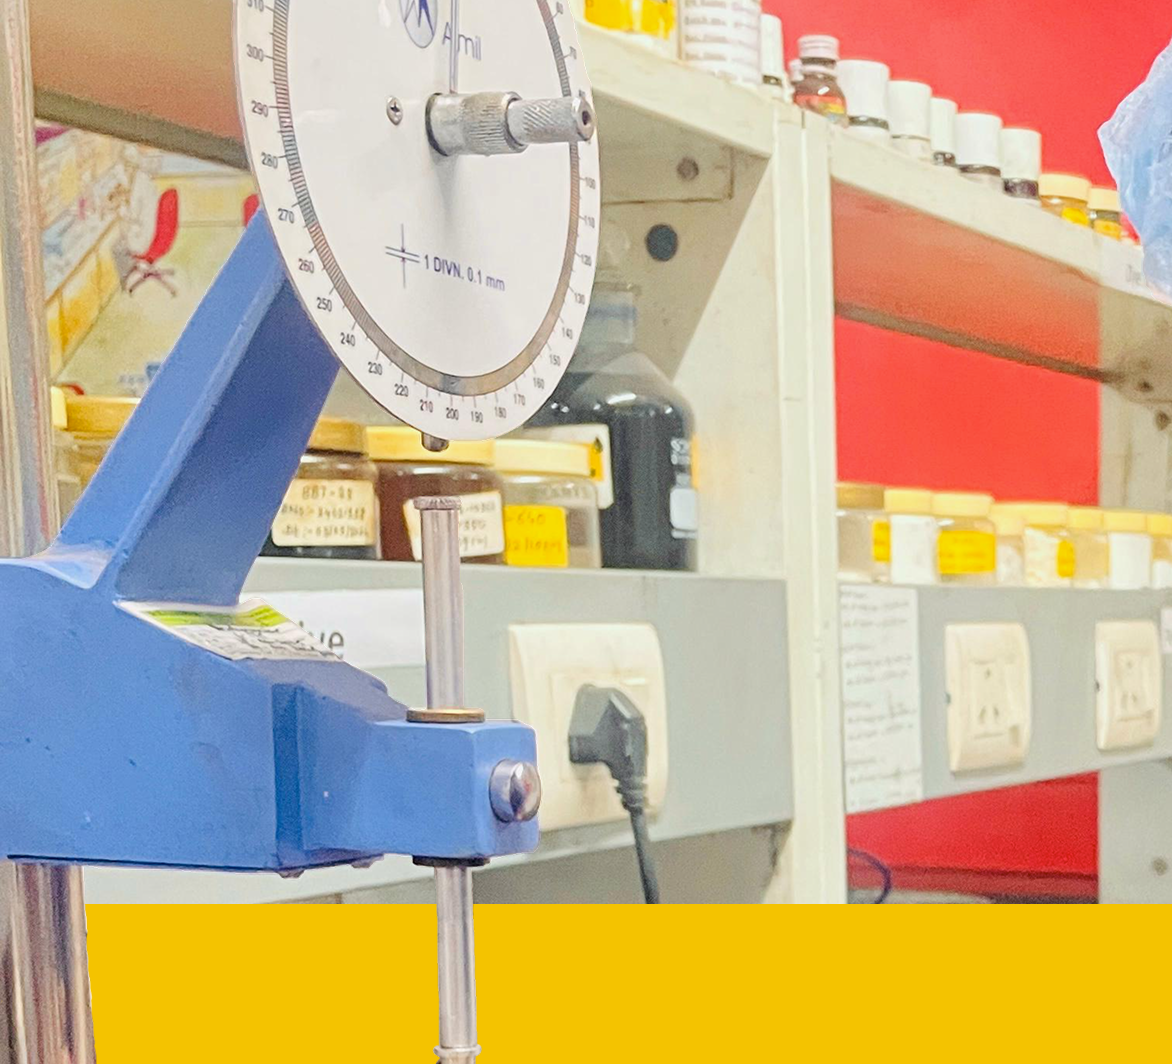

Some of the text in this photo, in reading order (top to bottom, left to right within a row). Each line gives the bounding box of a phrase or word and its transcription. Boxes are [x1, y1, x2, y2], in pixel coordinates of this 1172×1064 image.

[246, 43, 264, 62] 300
[251, 100, 268, 118] 290
[261, 152, 278, 169] 280
[278, 208, 295, 224] 270
[298, 258, 314, 274] 260
[425, 254, 505, 291] 1 DIVN. 0.1 mm
[316, 296, 332, 312] 250
[340, 332, 356, 347] 240
[562, 327, 573, 340] 140
[549, 353, 561, 367] 150
[368, 361, 383, 376] 230
[394, 383, 409, 398] 220
[532, 377, 545, 390] 160
[420, 399, 434, 413] 210
[513, 393, 526, 406] 170
[446, 407, 459, 421] 200
[470, 411, 484, 424] 190
[494, 406, 507, 419] 180
